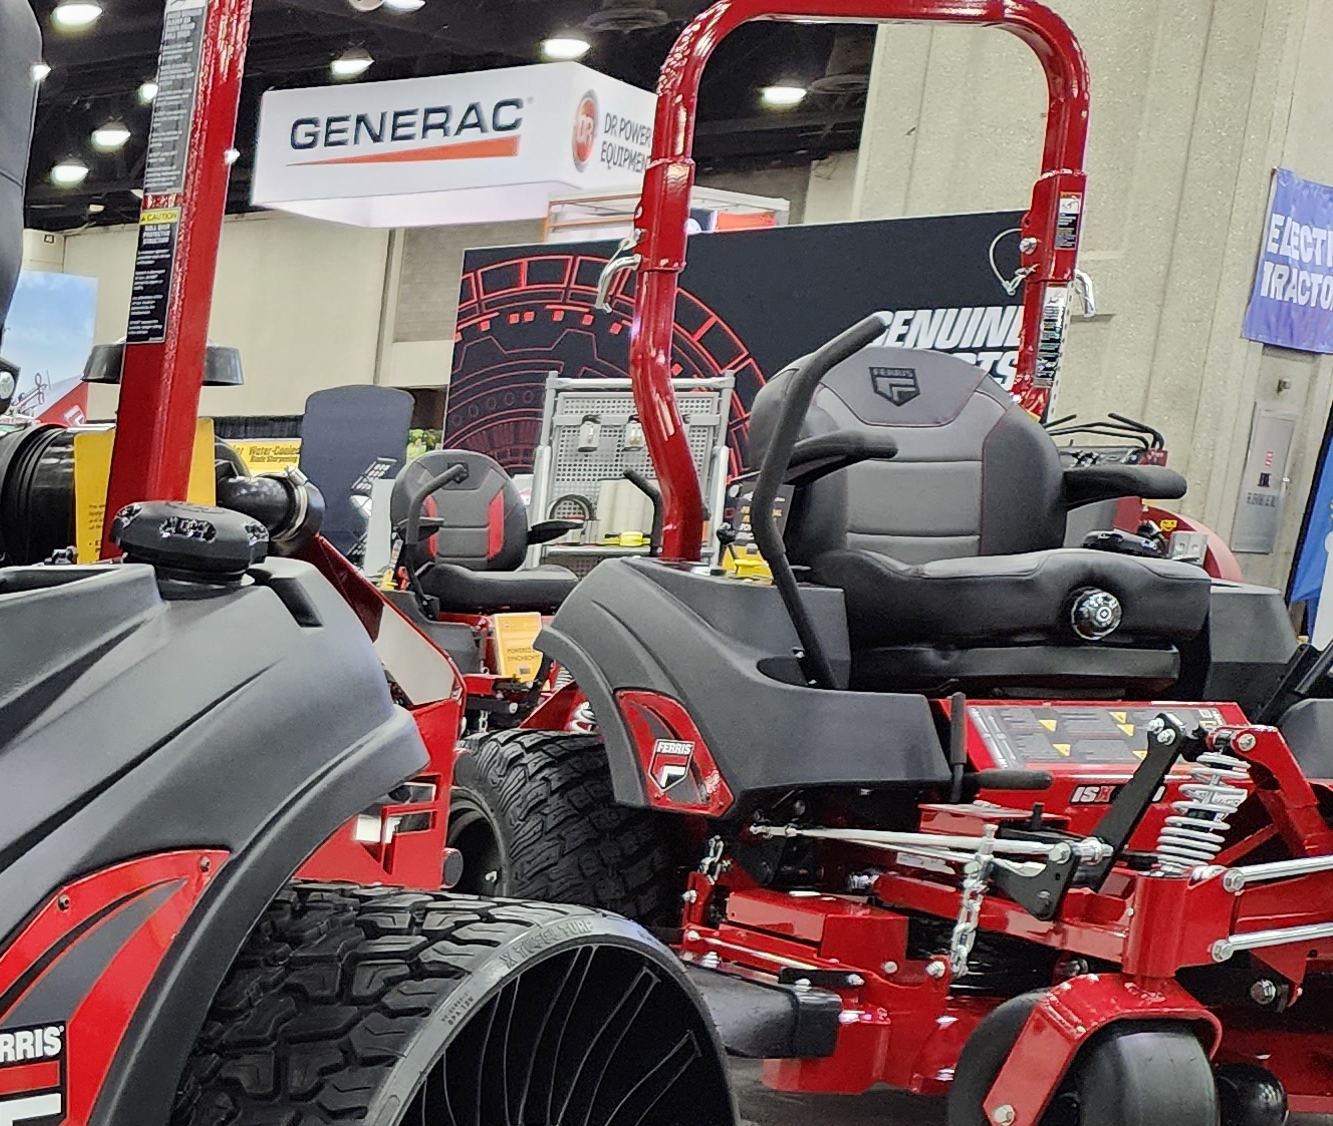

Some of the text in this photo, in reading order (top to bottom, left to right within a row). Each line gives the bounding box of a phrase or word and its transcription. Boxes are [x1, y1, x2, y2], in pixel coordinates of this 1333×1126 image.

[290, 98, 523, 150] GENERAC
[603, 112, 617, 135] DR
[600, 140, 650, 175] EQUIPMEN
[1266, 213, 1333, 267] ELECT
[1260, 261, 1333, 310] TRACTO
[656, 741, 692, 755] FERRIS
